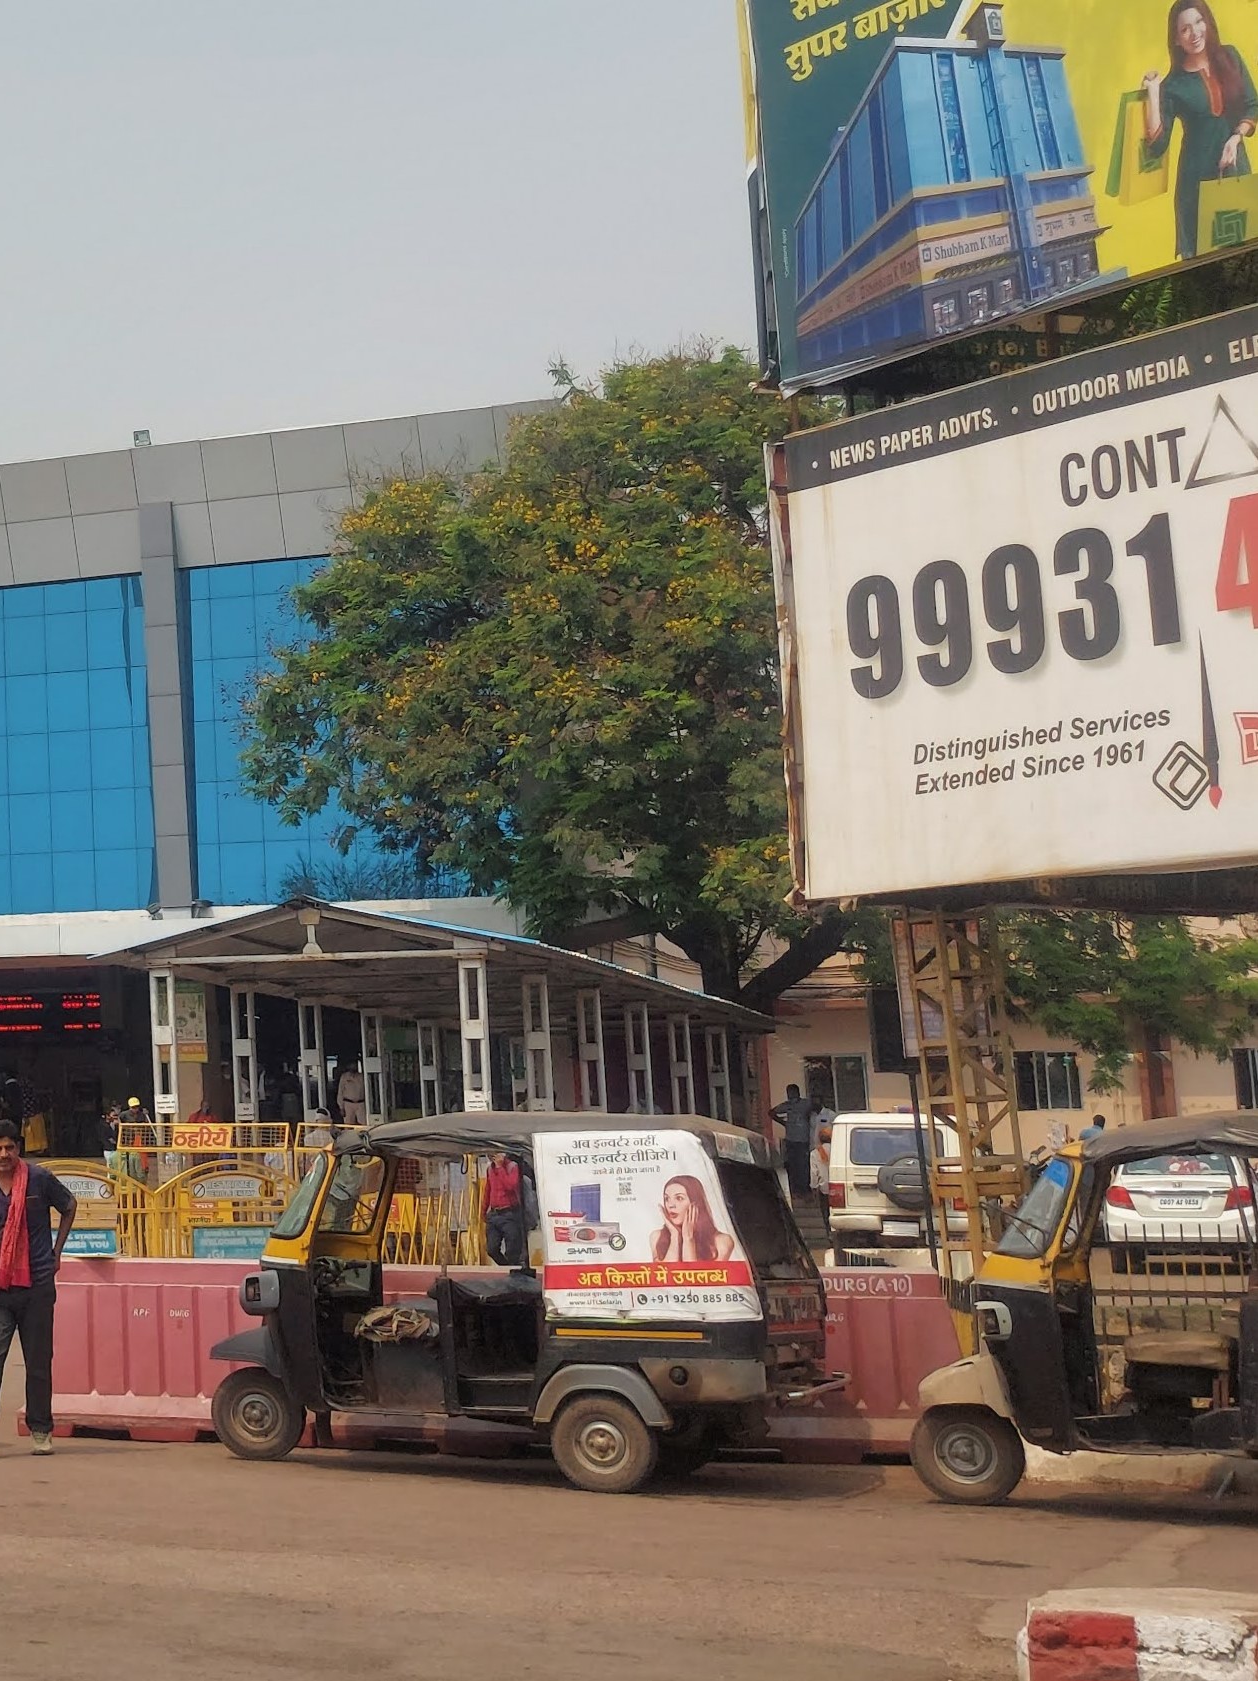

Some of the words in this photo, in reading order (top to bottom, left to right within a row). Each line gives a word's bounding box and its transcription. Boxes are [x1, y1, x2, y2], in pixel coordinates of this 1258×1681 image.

[784, 20, 848, 82] सुपर
[934, 242, 979, 261] Shubham
[980, 236, 988, 250] K
[990, 232, 1010, 248] Mart
[829, 438, 876, 471] NEWS
[879, 424, 934, 457] PAPER
[937, 407, 999, 440] ADVTS.
[1032, 373, 1121, 416] OUTDOOR
[1125, 354, 1191, 391] MEDIA
[846, 511, 1182, 701] 99931
[913, 721, 1062, 766] Distinguished
[1070, 706, 1172, 741] Services
[915, 757, 1015, 795] Extended
[1022, 746, 1085, 779] Since
[1092, 739, 1147, 768] 1961
[174, 1125, 229, 1149] ठहरिये
[572, 1139, 590, 1149] अब
[557, 1152, 588, 1165] सोलर
[577, 1271, 603, 1286] अब
[605, 1265, 652, 1286] किश्तों
[653, 1264, 668, 1285] में
[671, 1268, 728, 1285] उपलब्ध
[650, 1294, 671, 1305] +91
[702, 1293, 722, 1303] 885
[725, 1292, 745, 1303] 885
[133, 1307, 151, 1318] RPF
